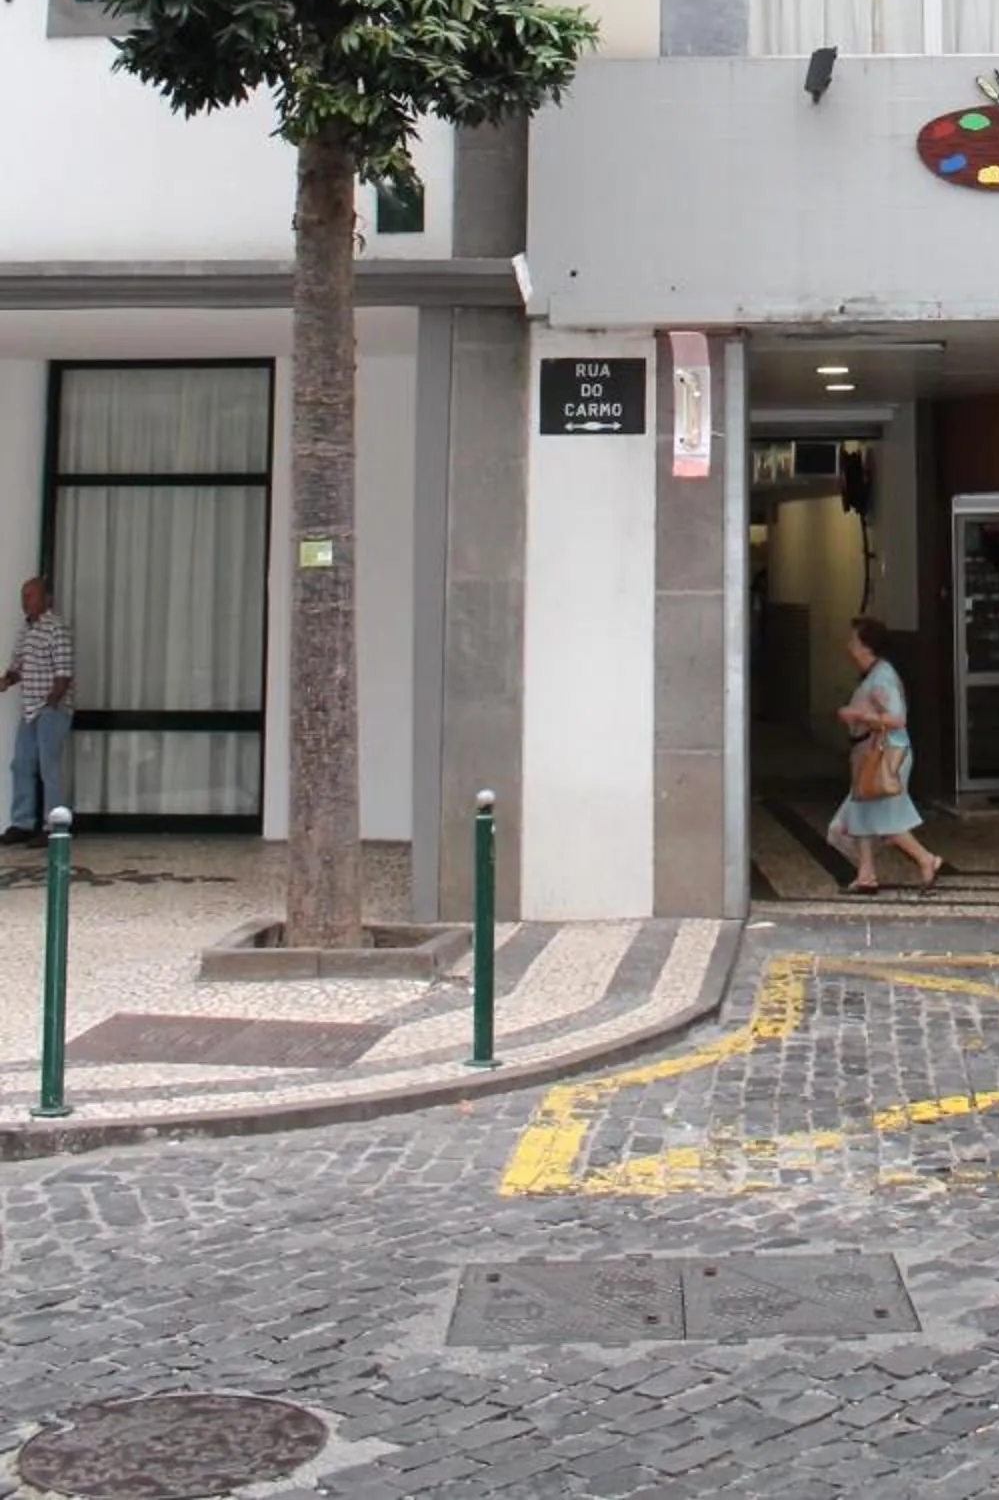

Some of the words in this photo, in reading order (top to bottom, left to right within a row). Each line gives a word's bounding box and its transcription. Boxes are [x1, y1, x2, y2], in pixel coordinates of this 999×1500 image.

[575, 363, 611, 378] RUA
[580, 383, 604, 397] DO
[564, 403, 623, 417] CARMO
